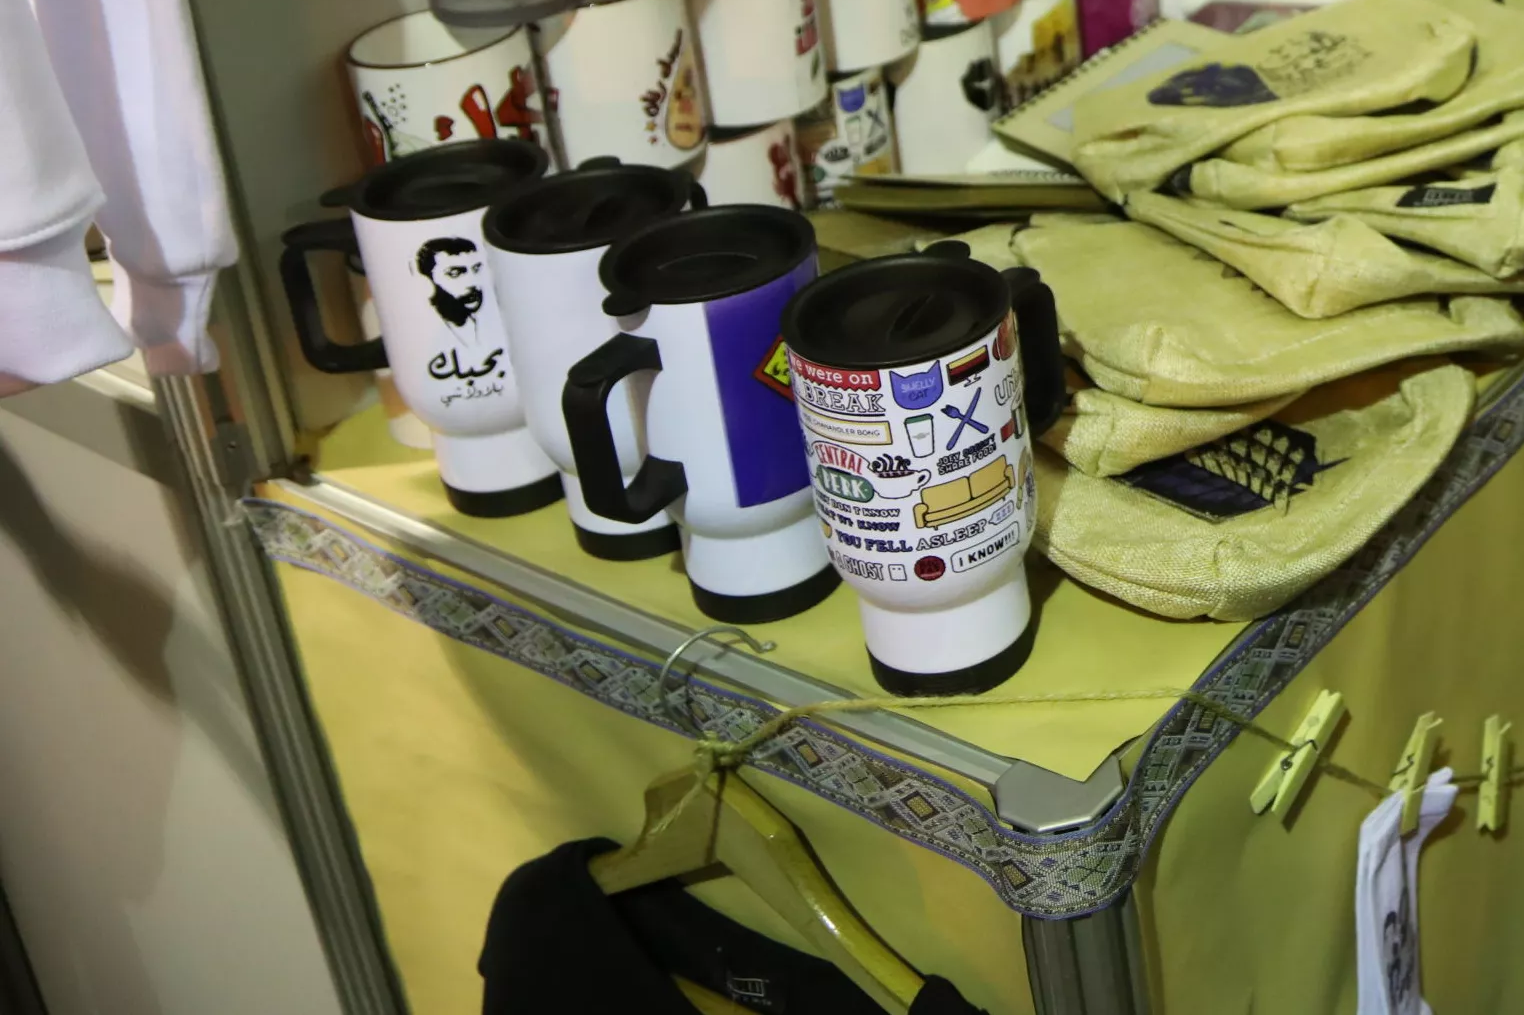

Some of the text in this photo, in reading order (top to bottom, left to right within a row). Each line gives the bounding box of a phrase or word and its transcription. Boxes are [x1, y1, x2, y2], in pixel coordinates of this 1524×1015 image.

[428, 347, 506, 386] بحبك
[804, 363, 843, 383] were
[848, 373, 874, 385] on
[803, 381, 887, 414] BREAK
[814, 443, 864, 476] CENTRAL
[936, 451, 961, 467] JOEY
[937, 457, 972, 476] SHARE
[821, 468, 866, 500] PERK
[856, 518, 901, 532] KNOW
[861, 507, 901, 518] KNOW
[834, 518, 987, 553] YOU FELL ASLEEP
[959, 556, 964, 568] I
[967, 529, 1016, 565] KNOW!!!
[842, 553, 885, 582] GHOST
